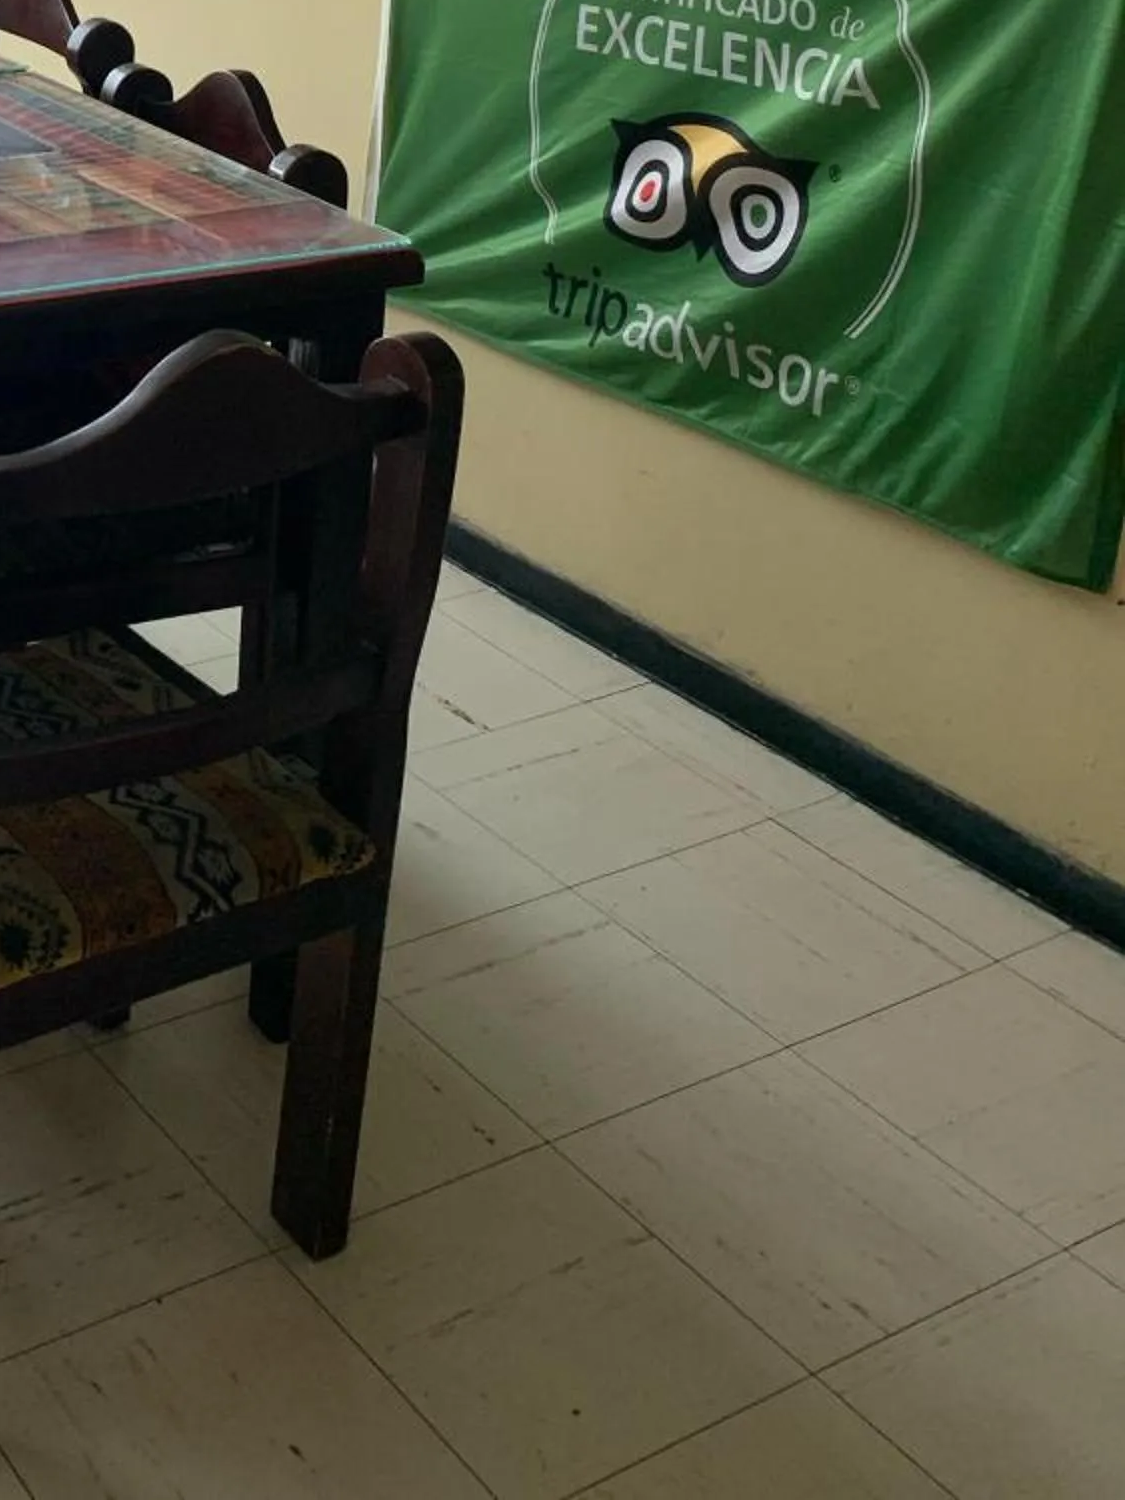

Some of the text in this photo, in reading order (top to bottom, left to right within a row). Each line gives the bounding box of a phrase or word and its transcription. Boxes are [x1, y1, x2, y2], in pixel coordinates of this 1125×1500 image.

[576, 4, 881, 111] EXCELENCIA
[829, 6, 866, 42] de
[542, 261, 840, 419] tripadvisor
